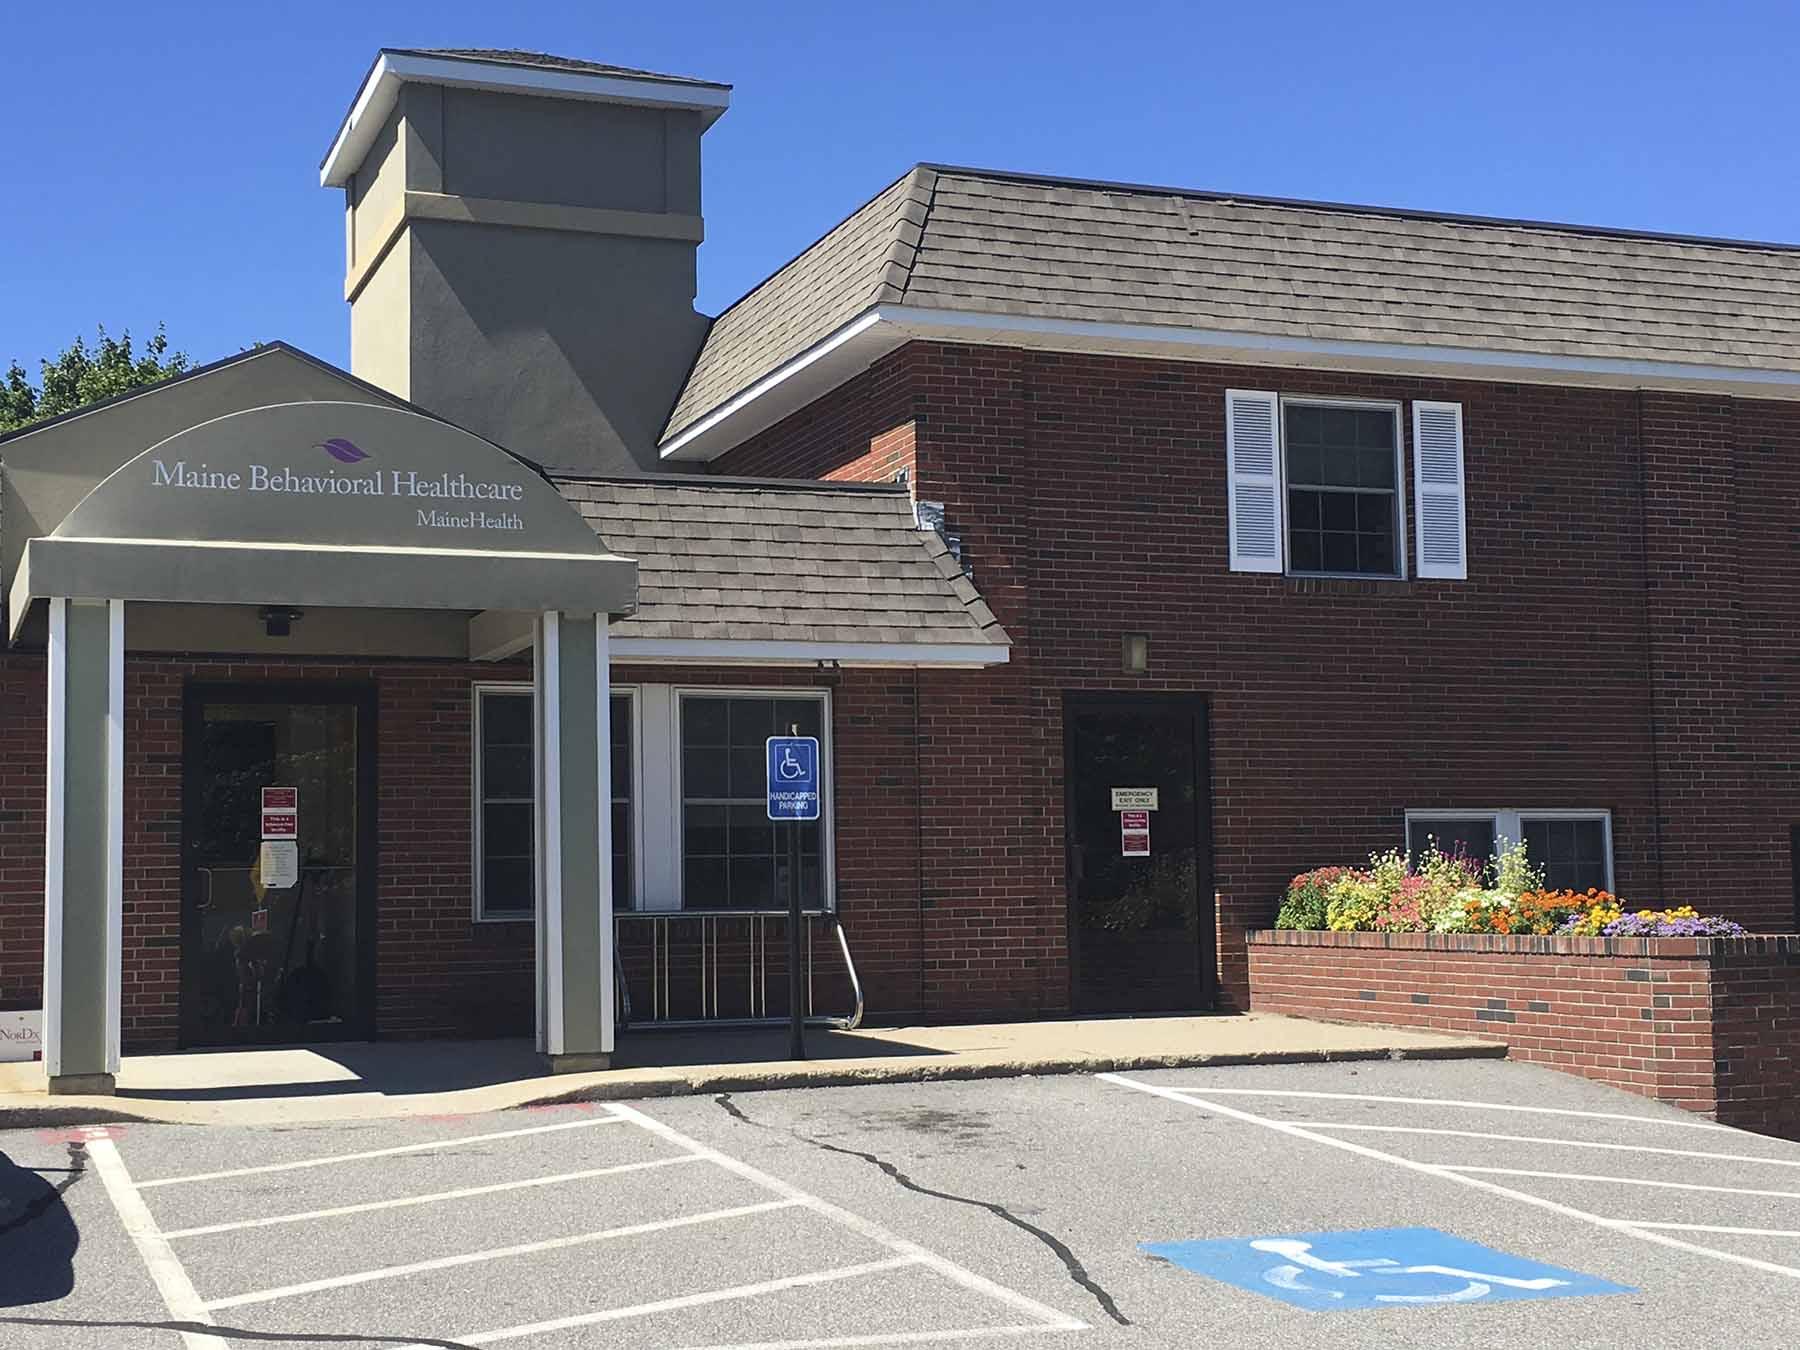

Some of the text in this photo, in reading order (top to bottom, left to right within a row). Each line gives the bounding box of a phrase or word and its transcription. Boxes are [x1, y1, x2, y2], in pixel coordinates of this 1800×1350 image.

[152, 459, 523, 501] Maine Behavioral Healthcare
[416, 509, 524, 530] MaineHealth
[770, 792, 817, 801] HANDICAPPED
[779, 801, 808, 810] PARKING
